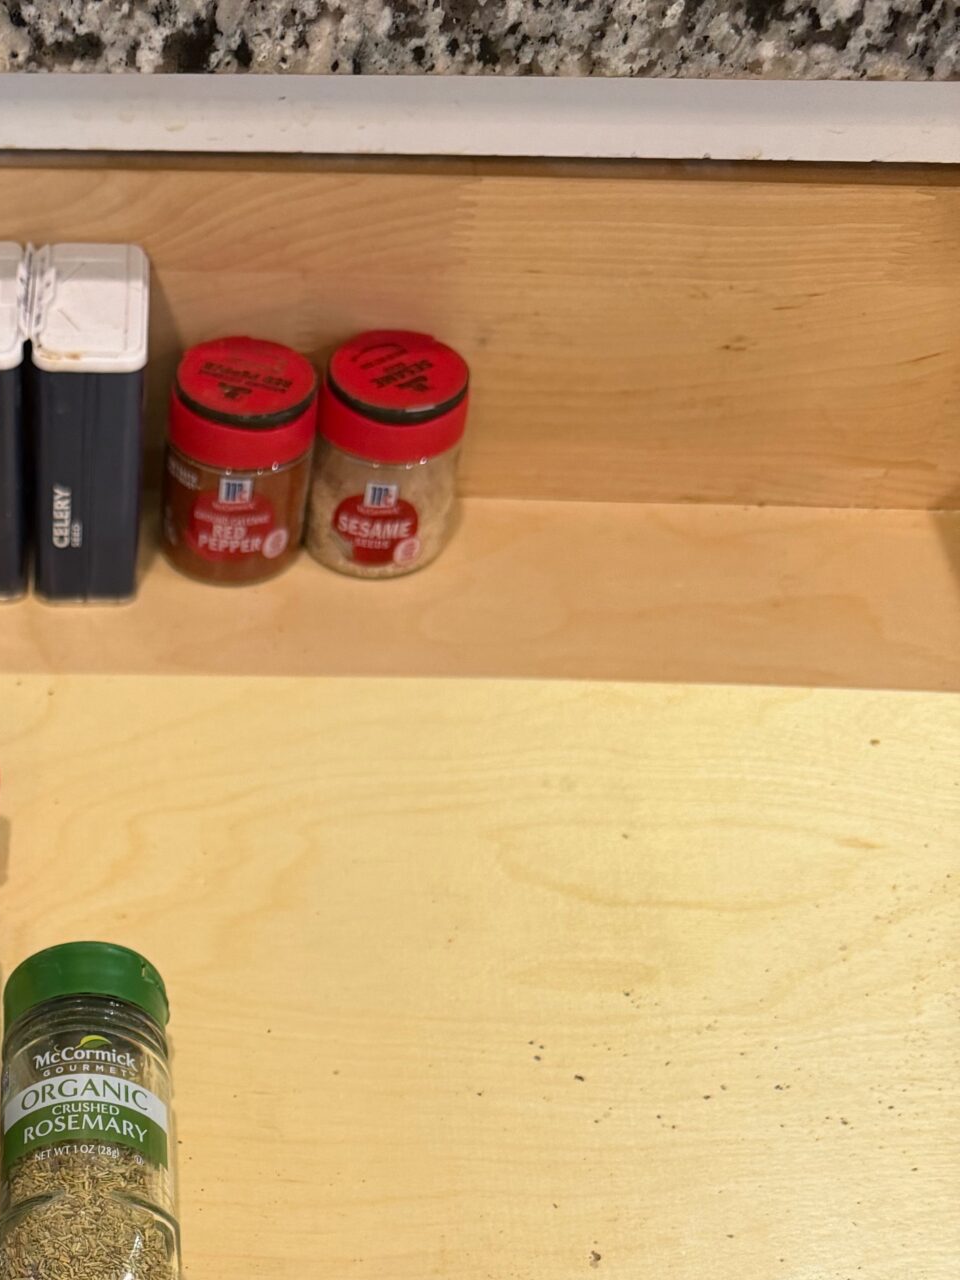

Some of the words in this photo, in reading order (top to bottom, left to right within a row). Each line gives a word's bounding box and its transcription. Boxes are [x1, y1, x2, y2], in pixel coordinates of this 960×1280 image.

[52, 484, 71, 549] CELERY
[337, 512, 413, 540] SESAME
[198, 532, 262, 553] PEPPER
[212, 524, 247, 540] RED
[33, 1047, 138, 1073] McCormick
[43, 1064, 128, 1077] GOURMET
[21, 1078, 148, 1111] ORGANIC
[52, 1102, 120, 1116] CRUSHED
[23, 1114, 148, 1144] ROSEMARY
[34, 1149, 51, 1162] NET
[52, 1145, 71, 1157] WT
[80, 1144, 95, 1154] OZ
[97, 1144, 120, 1159] (28g)
